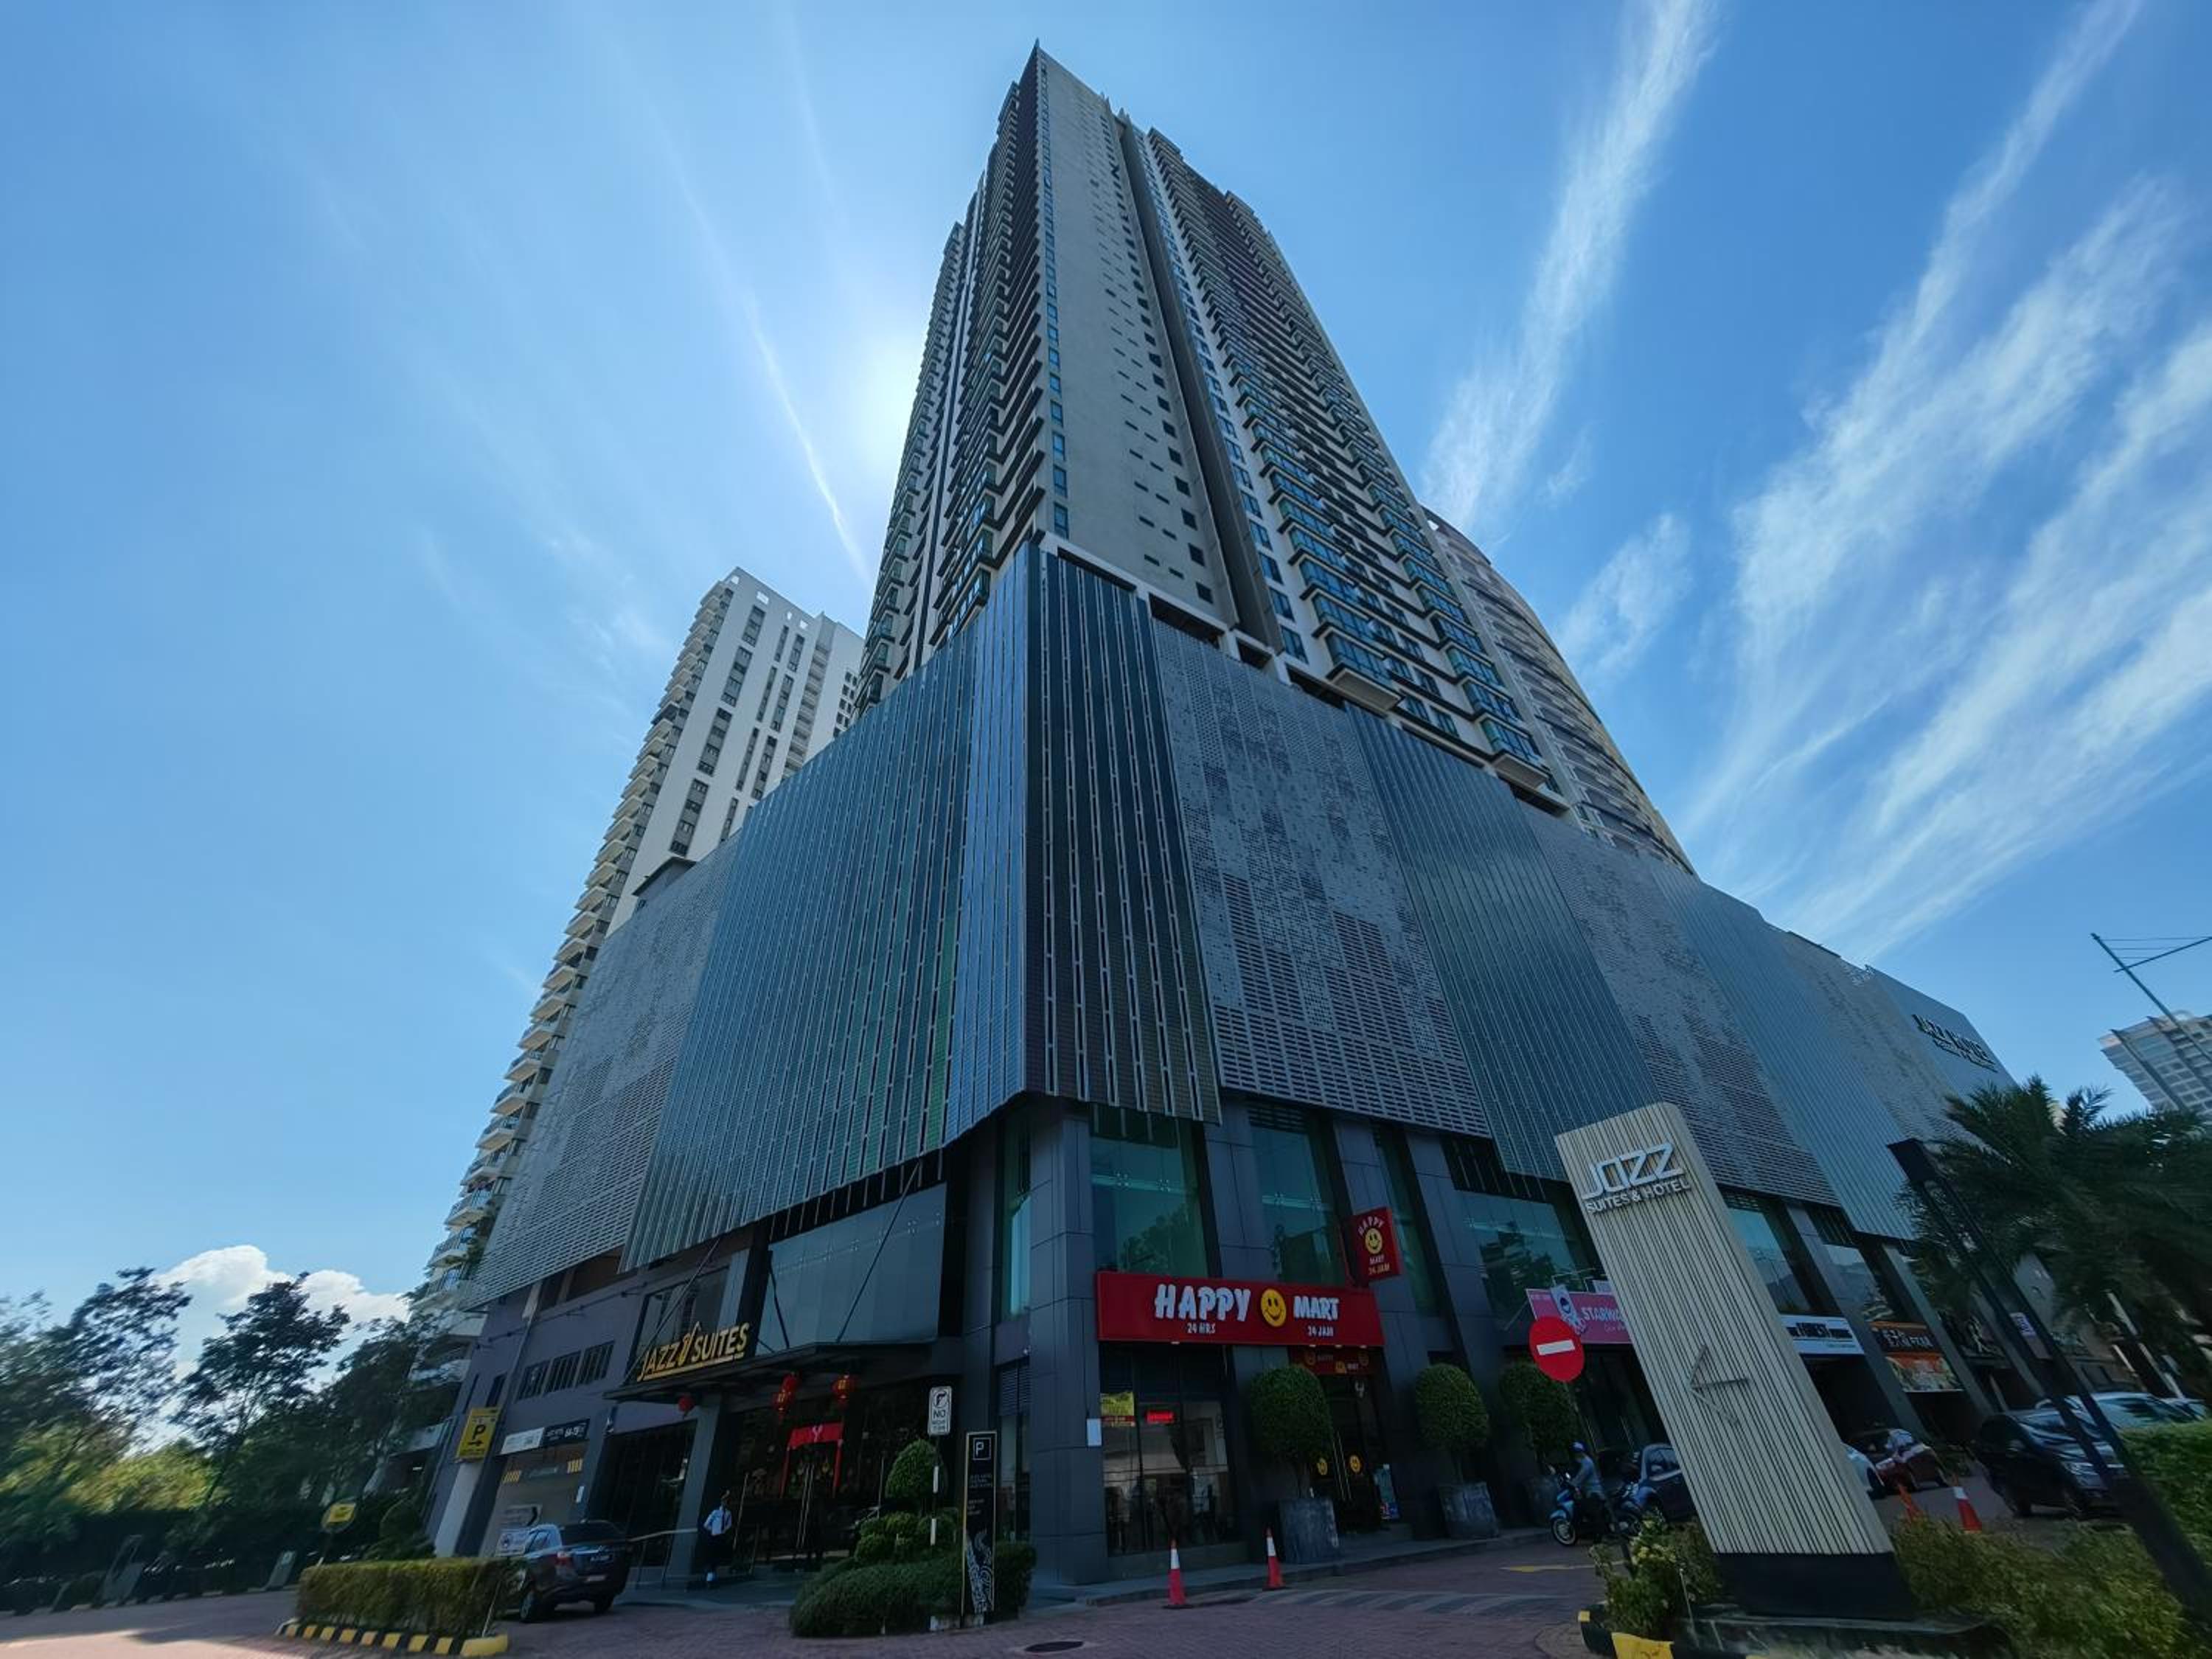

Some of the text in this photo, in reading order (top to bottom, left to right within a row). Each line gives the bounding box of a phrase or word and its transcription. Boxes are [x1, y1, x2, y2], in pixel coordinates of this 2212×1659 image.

[1585, 1177, 1691, 1214] SUITES & HOTEL
[1155, 1284, 1340, 1322] HAPPY MART
[1186, 1322, 1216, 1335] 24 HRS
[636, 1322, 751, 1382] JAZZ SUITES
[472, 1424, 487, 1441] P
[975, 1441, 985, 1458] P
